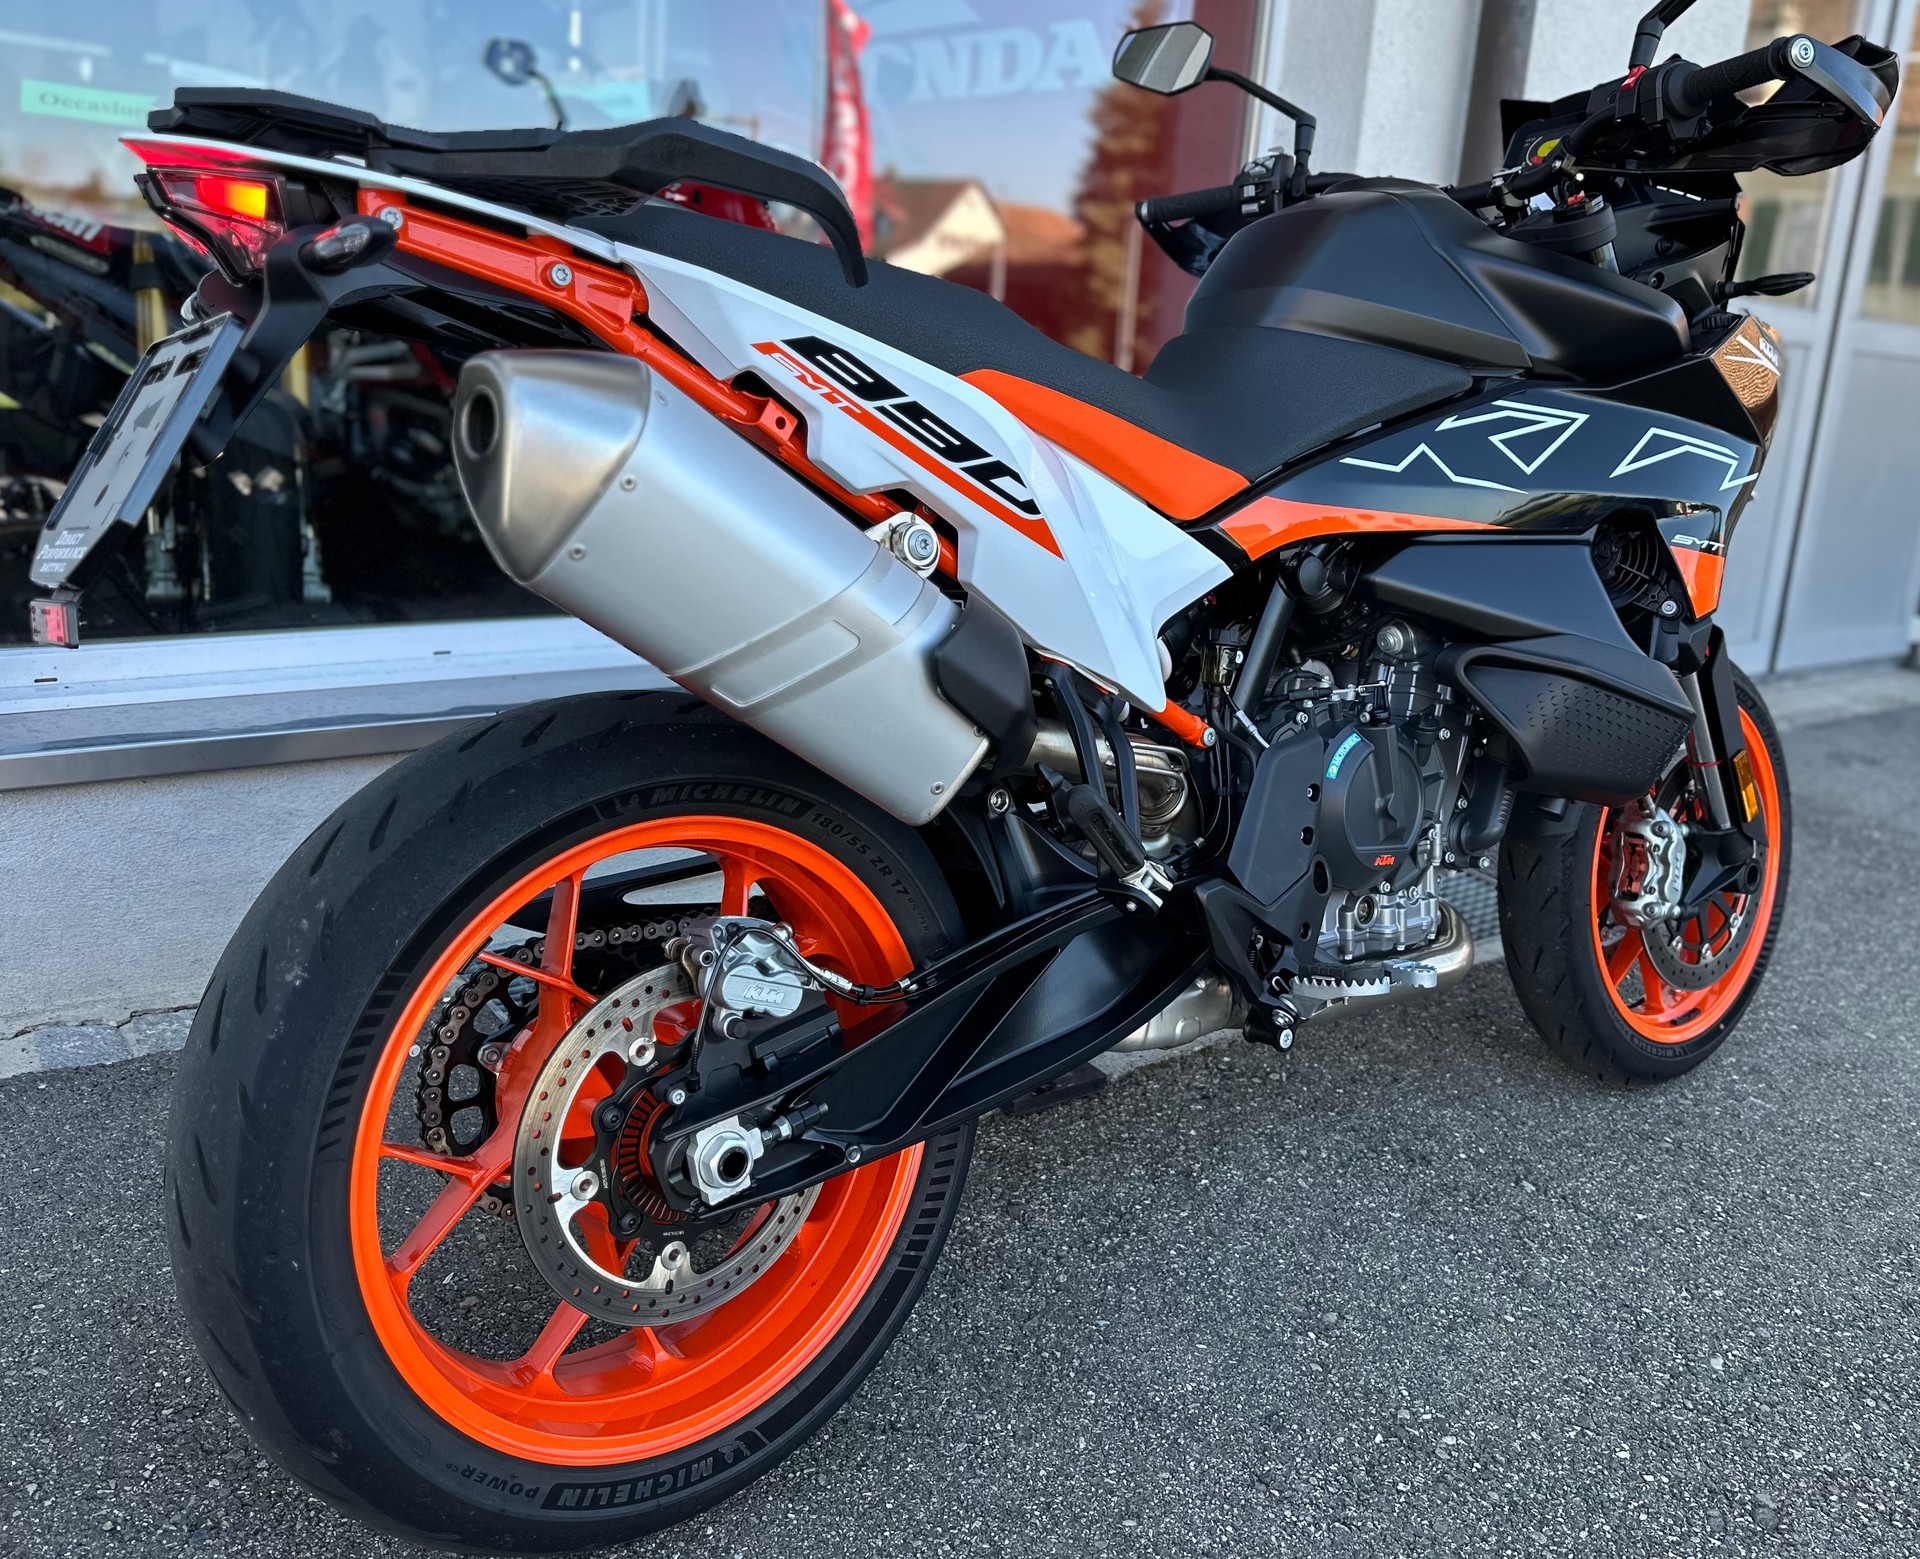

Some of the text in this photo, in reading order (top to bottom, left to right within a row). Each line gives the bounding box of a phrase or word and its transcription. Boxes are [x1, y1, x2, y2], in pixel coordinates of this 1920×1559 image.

[36, 544, 88, 559] PERFORMANCE
[1671, 534, 1725, 551] SMT
[650, 783, 800, 814] MICHELIN
[811, 812, 871, 856] 180/55
[869, 855, 893, 878] ZR
[890, 878, 911, 896] 17
[1374, 854, 1396, 867] KTM
[743, 982, 785, 1004] KTM
[461, 1463, 541, 1499] POWER
[556, 1456, 714, 1507] MICHELIN
